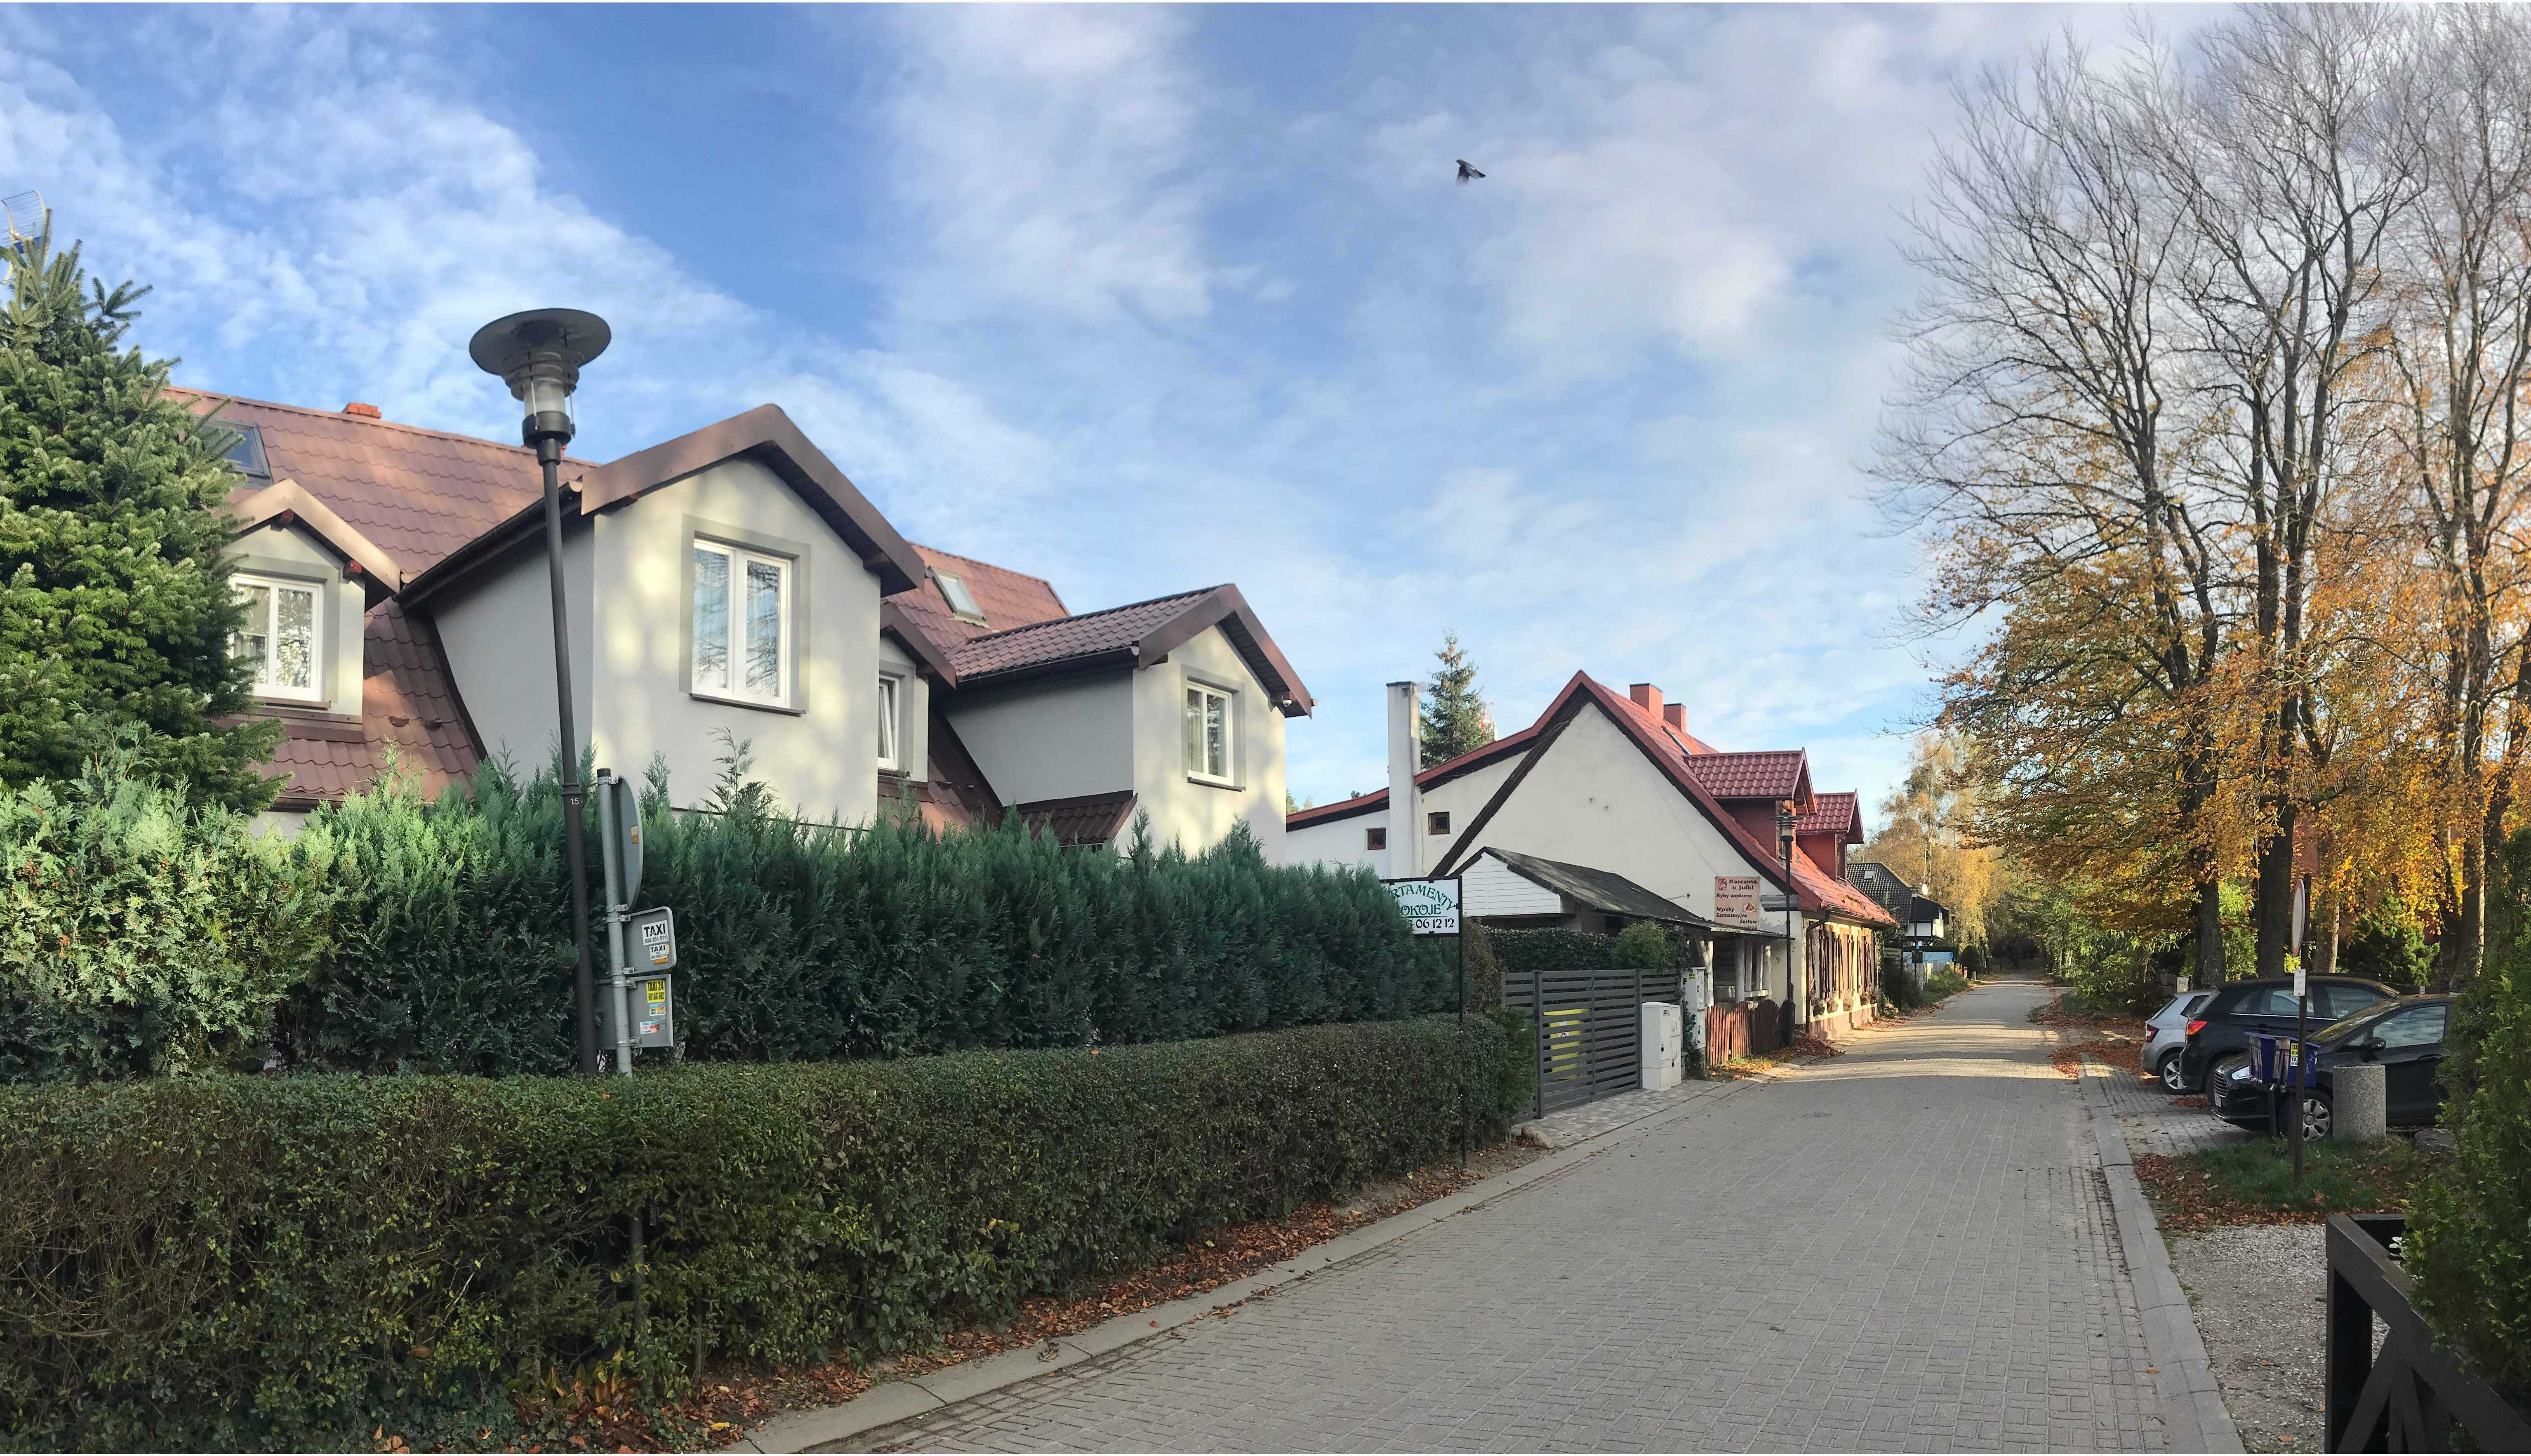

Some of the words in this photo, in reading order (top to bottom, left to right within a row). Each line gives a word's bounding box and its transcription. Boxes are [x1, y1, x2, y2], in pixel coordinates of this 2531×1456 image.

[1391, 884, 1456, 910] RTAMENTY
[1401, 904, 1441, 915] OKOJE
[1416, 918, 1429, 928] 06
[1433, 919, 1442, 928] 12
[1445, 918, 1454, 928] 12
[644, 923, 666, 937] TAXI
[647, 981, 657, 991] TAXI
[658, 981, 664, 990] 24
